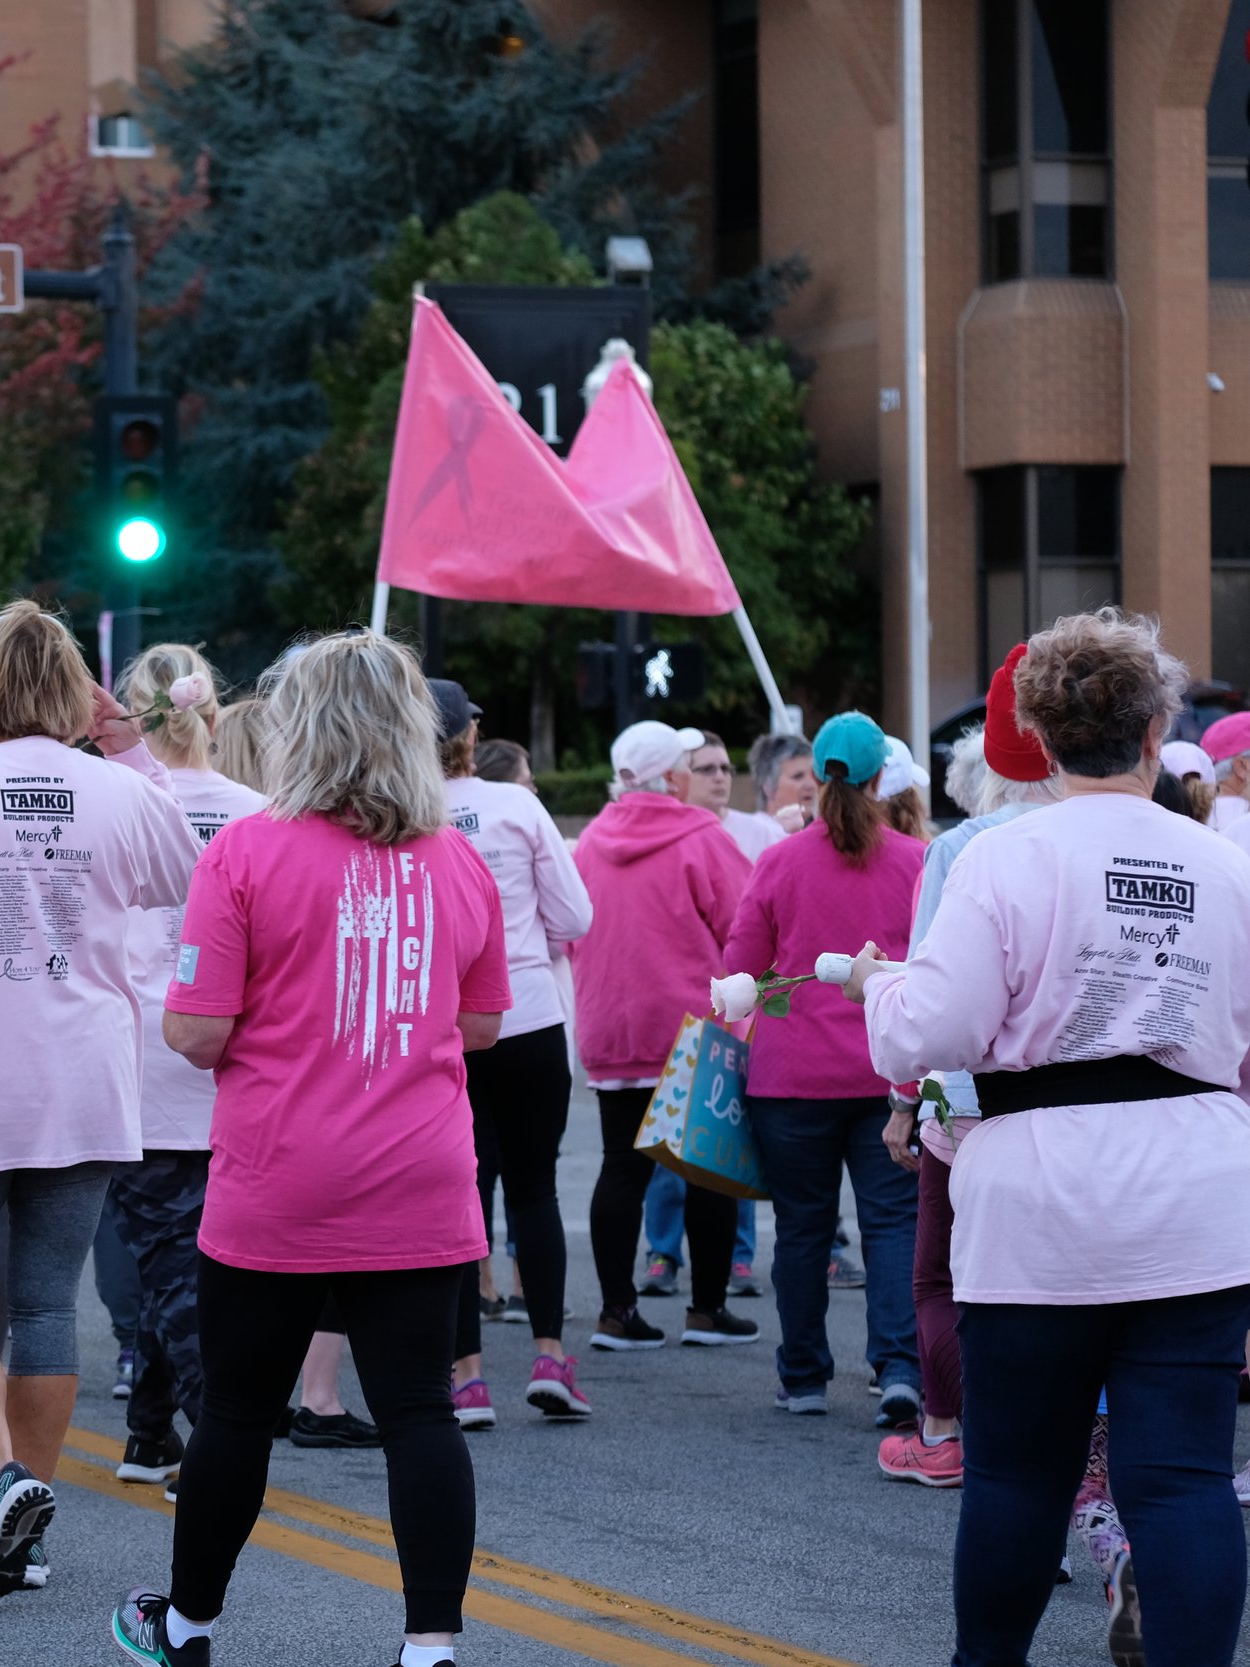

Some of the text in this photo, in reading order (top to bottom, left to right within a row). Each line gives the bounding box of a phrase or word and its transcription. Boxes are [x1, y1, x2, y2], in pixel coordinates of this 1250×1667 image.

[5, 776, 65, 785] PRESENTED BY
[6, 793, 68, 810] TAMKO
[3, 813, 75, 823] BUILDING PRODUCTS
[15, 829, 52, 846] Mercy
[55, 848, 93, 863] FREEMAN
[1113, 857, 1185, 873] PRESENTED BY
[1111, 877, 1188, 905] TAMKO
[1106, 904, 1195, 924] BUILDING PRODUCTS
[1119, 925, 1167, 949] Mercy
[396, 852, 421, 1057] FIGHT
[1169, 953, 1212, 977] FREEMAN
[709, 1040, 748, 1079] PEA
